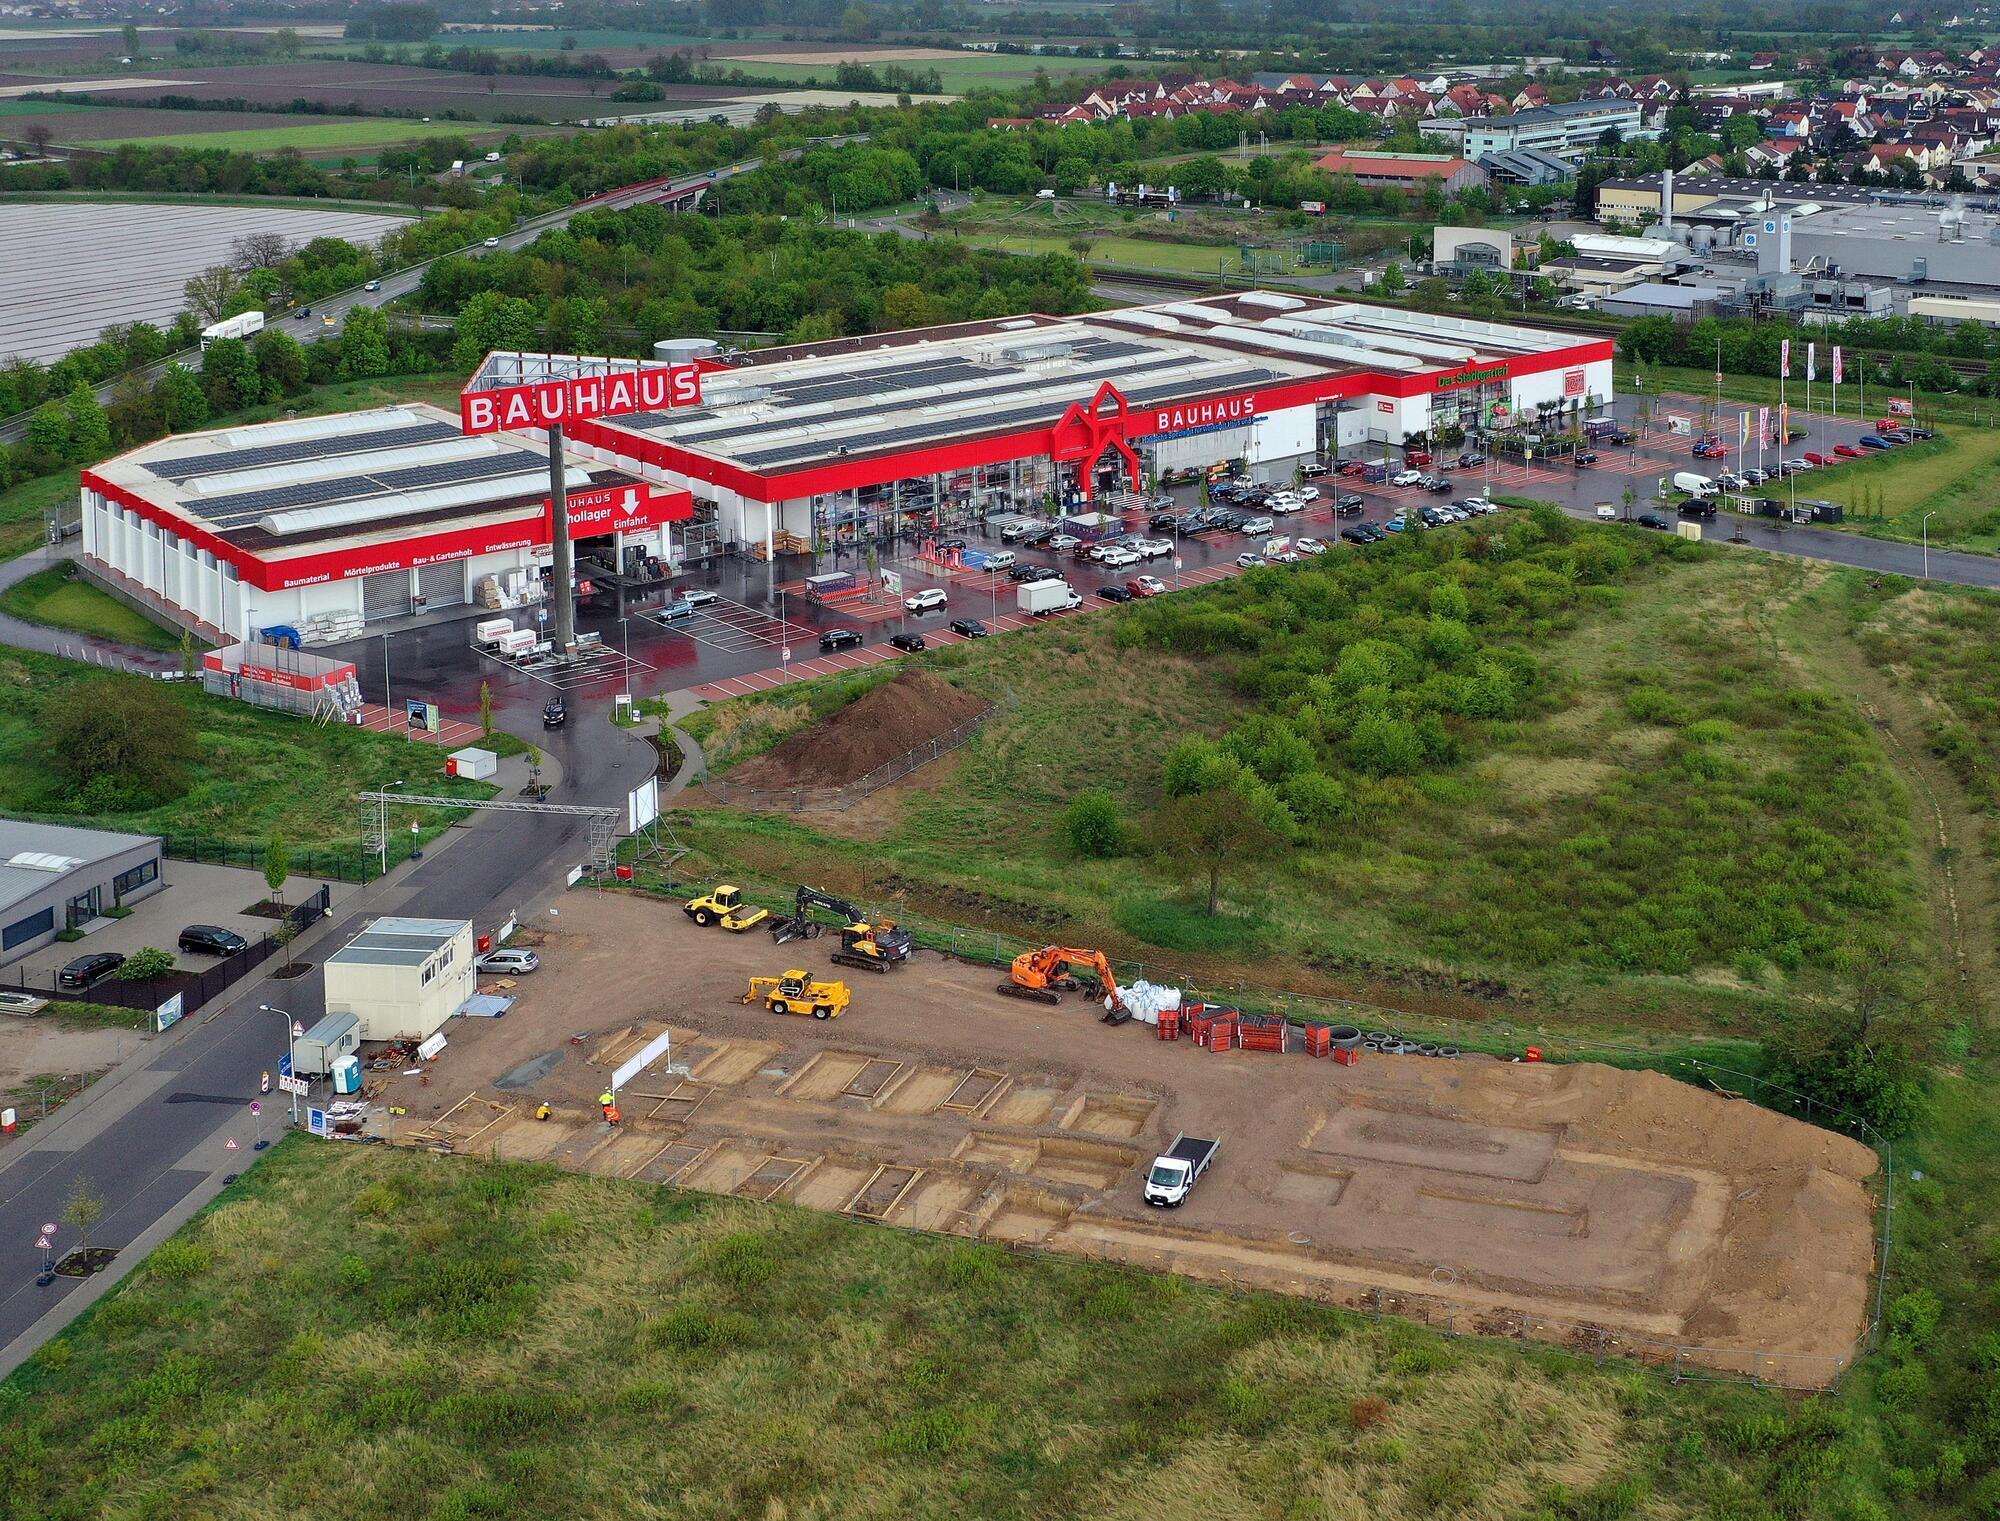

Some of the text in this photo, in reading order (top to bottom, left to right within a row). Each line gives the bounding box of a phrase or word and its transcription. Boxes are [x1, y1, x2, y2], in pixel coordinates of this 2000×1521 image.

[470, 371, 698, 429] BAUHAUS
[1158, 398, 1254, 430] BAUHAUS
[569, 493, 611, 508] UHAUS
[567, 508, 612, 525] hollager
[613, 514, 648, 530] Einfahrt
[485, 539, 531, 552] Entwässerung
[436, 548, 473, 561] Gartenholz
[343, 561, 400, 578] Mörtelprodukte
[284, 572, 330, 588] Baumaterial
